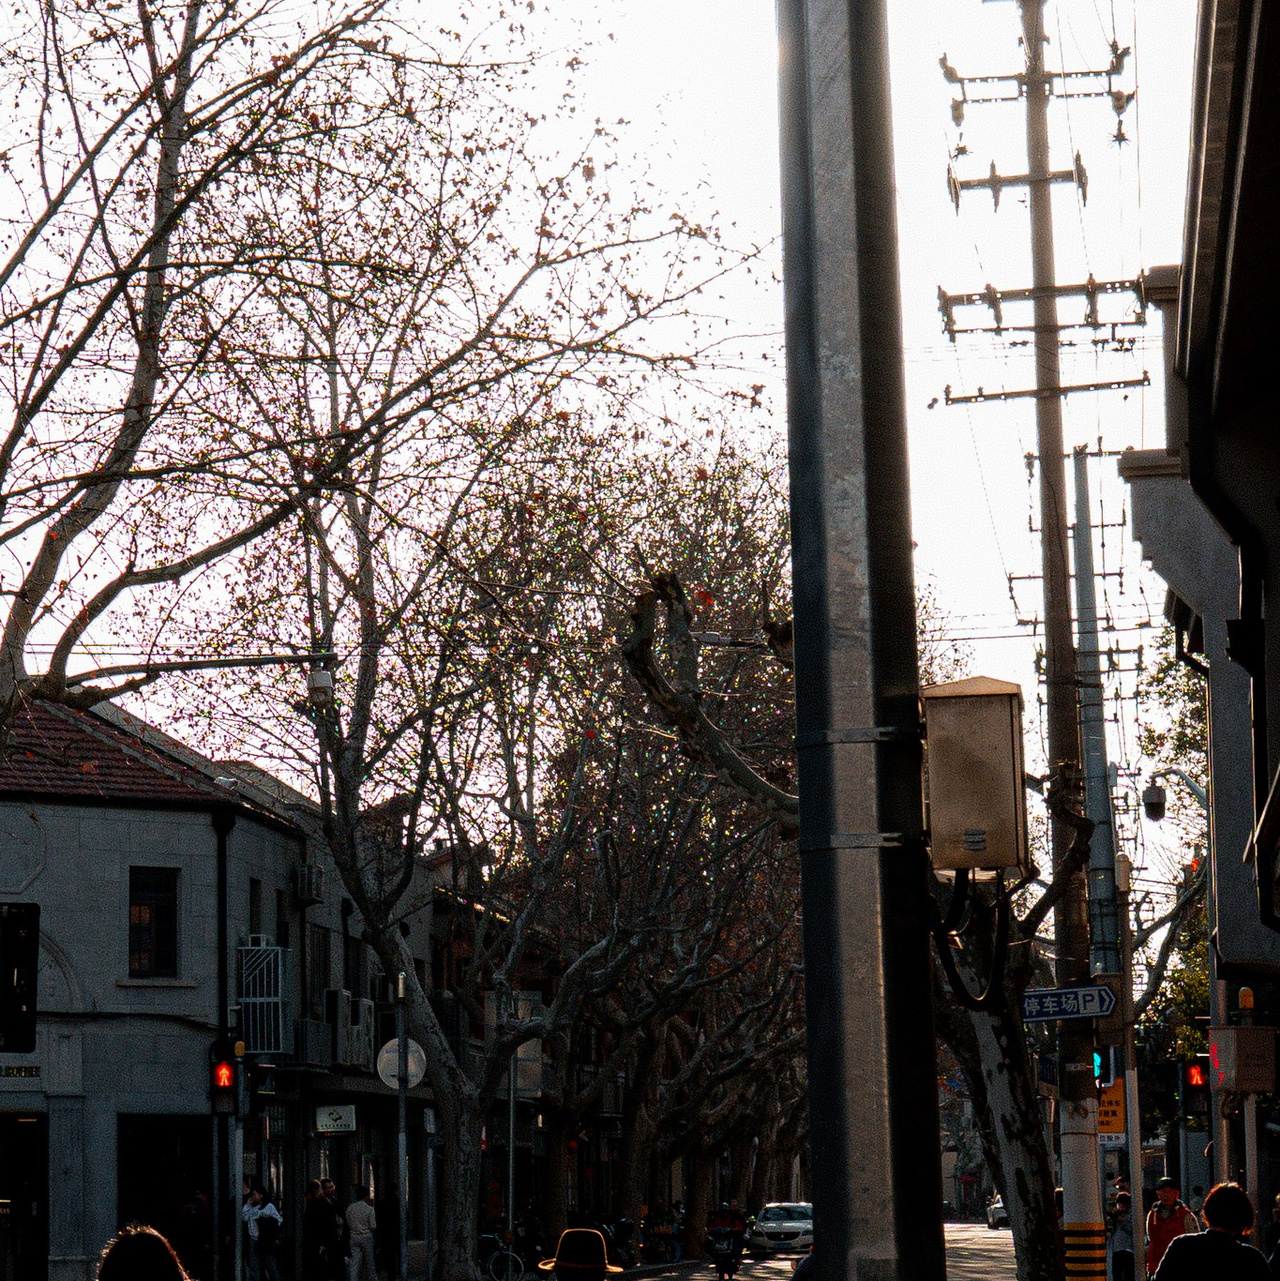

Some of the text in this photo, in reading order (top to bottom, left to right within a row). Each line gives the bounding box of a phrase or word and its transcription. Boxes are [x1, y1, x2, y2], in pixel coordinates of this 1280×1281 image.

[1024, 993, 1094, 1016] 停车场 P
